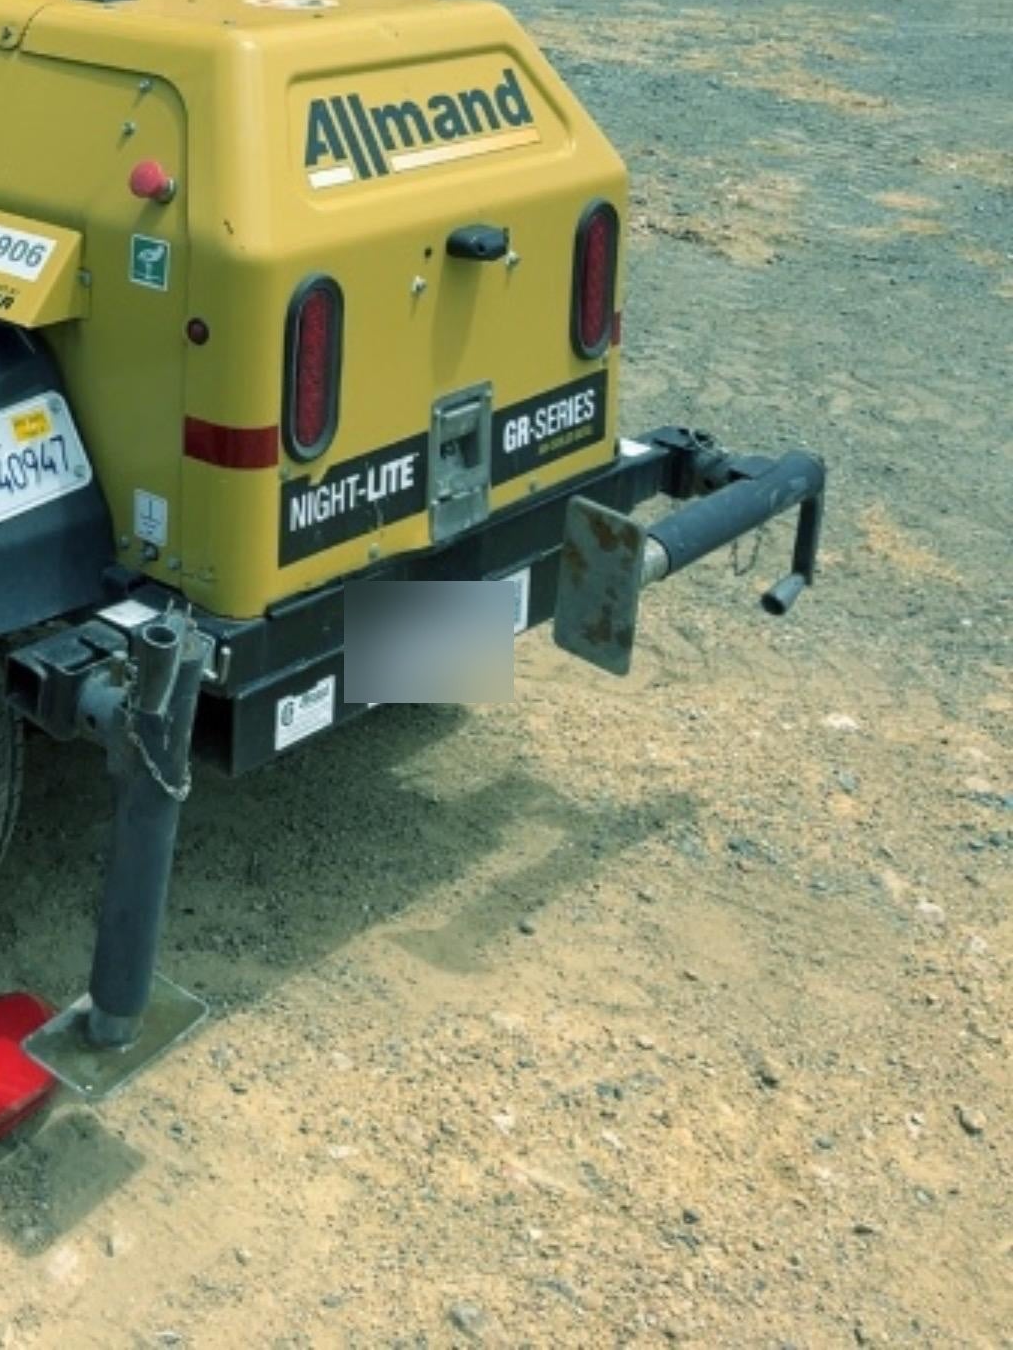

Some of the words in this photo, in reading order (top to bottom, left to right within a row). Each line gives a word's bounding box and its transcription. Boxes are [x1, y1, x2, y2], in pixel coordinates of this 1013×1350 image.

[305, 68, 533, 179] Allmand
[503, 388, 595, 454] GR-SERIES
[289, 453, 417, 532] NIGHT-LITE
